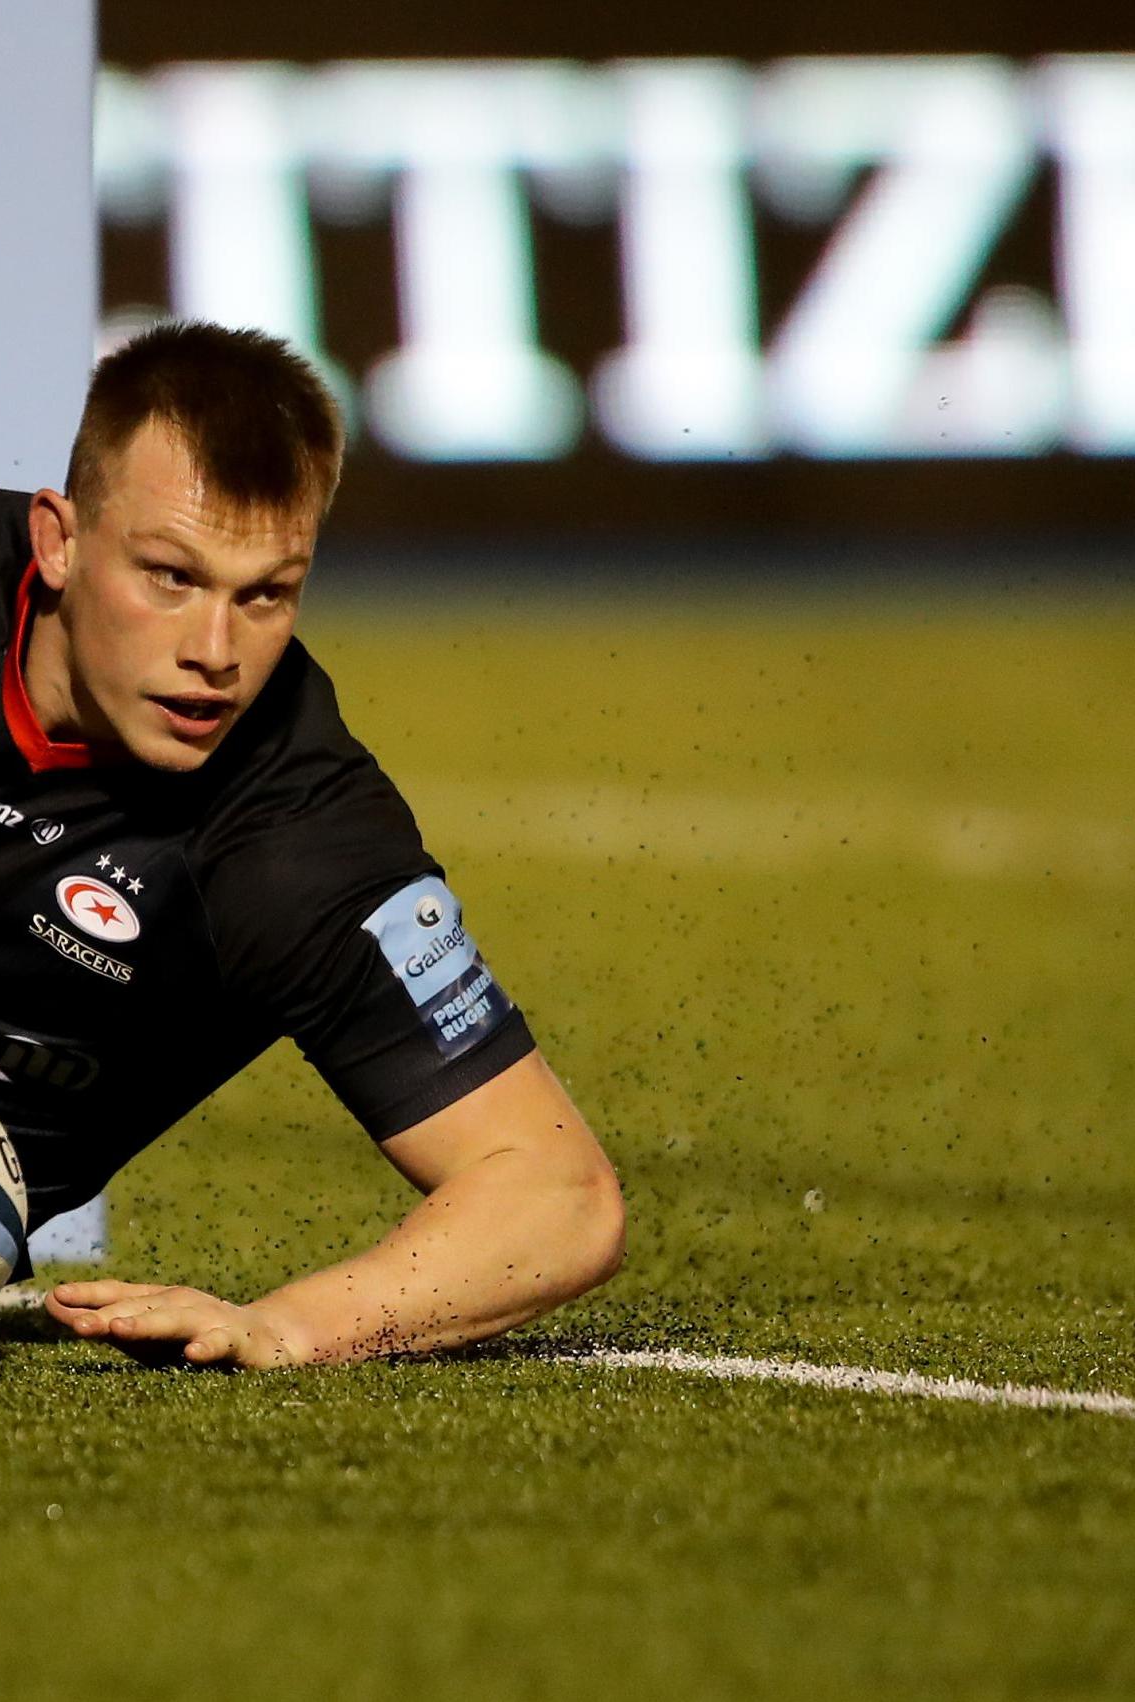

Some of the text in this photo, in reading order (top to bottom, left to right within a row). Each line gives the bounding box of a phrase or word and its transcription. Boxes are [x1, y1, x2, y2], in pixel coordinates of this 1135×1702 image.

[97, 54, 1135, 462] ITIZ
[29, 914, 134, 983] SARACENS
[432, 968, 492, 1027] PREMIER
[440, 995, 491, 1041] RUGBY
